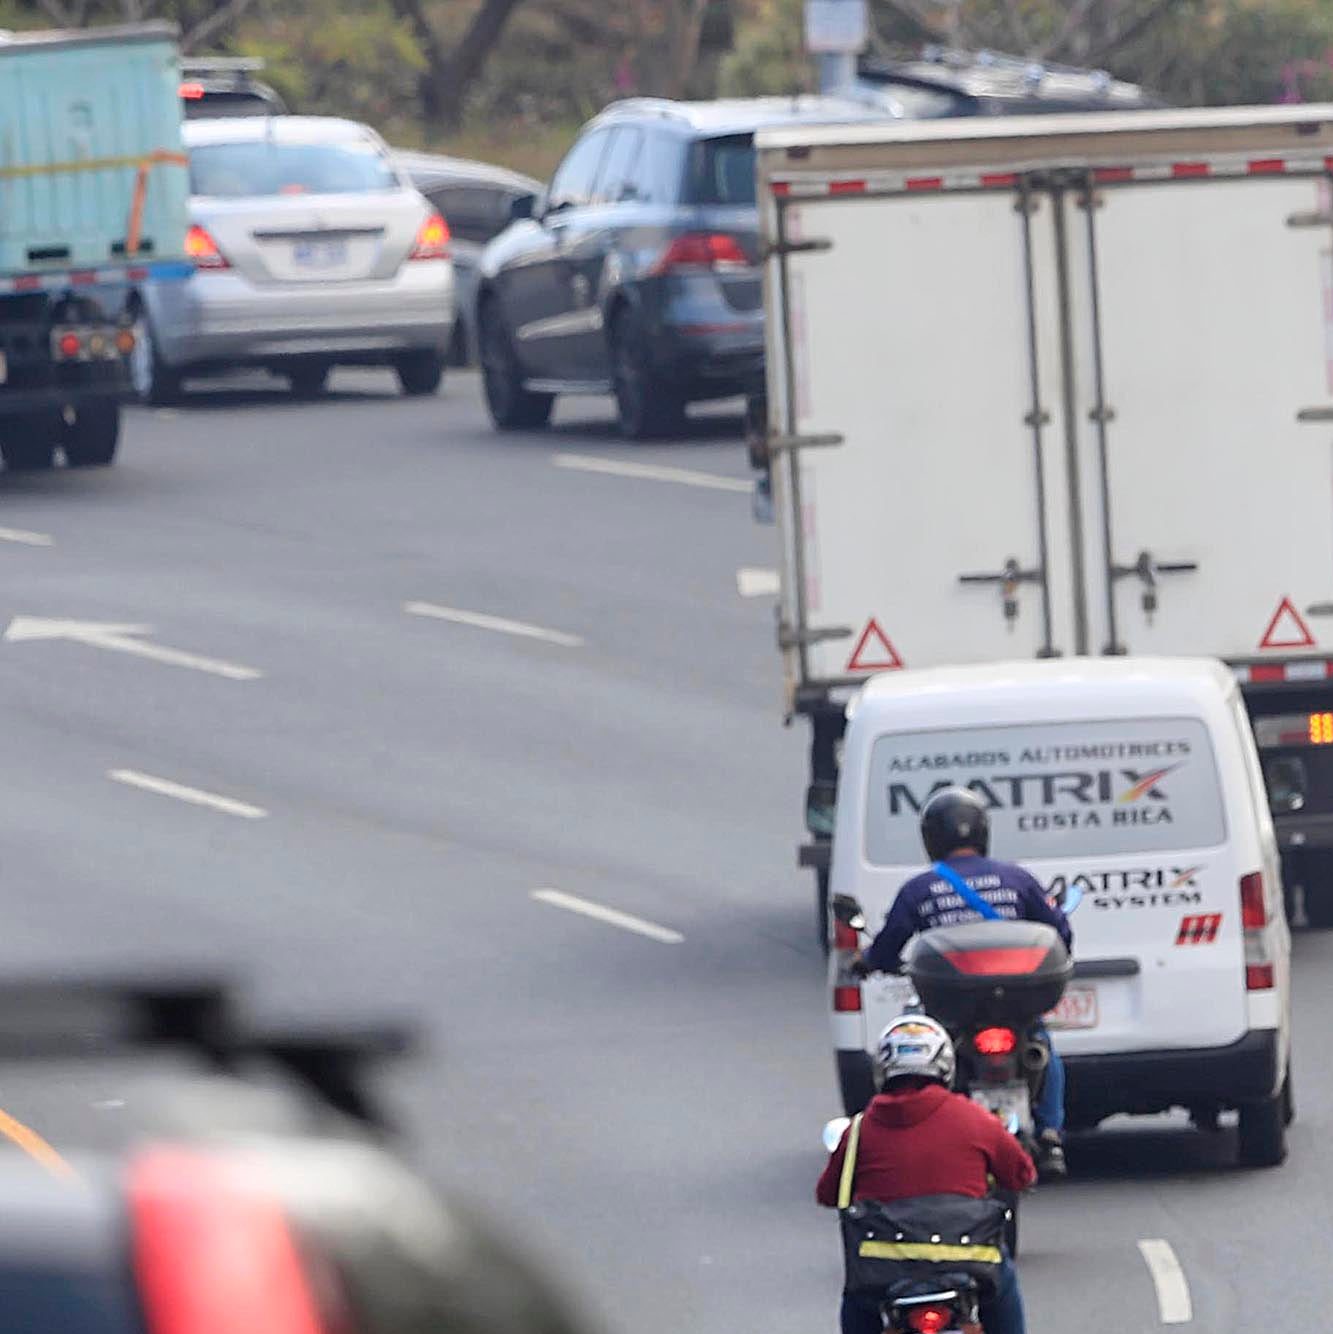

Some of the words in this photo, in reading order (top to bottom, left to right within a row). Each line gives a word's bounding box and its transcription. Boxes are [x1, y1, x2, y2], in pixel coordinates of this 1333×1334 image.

[889, 750, 1011, 772] ACABADOS
[1019, 738, 1192, 764] AUTOMOTRICES
[1017, 811, 1102, 833] COSTA
[1112, 807, 1175, 827] RICA
[1093, 891, 1203, 910] SYSTEM
